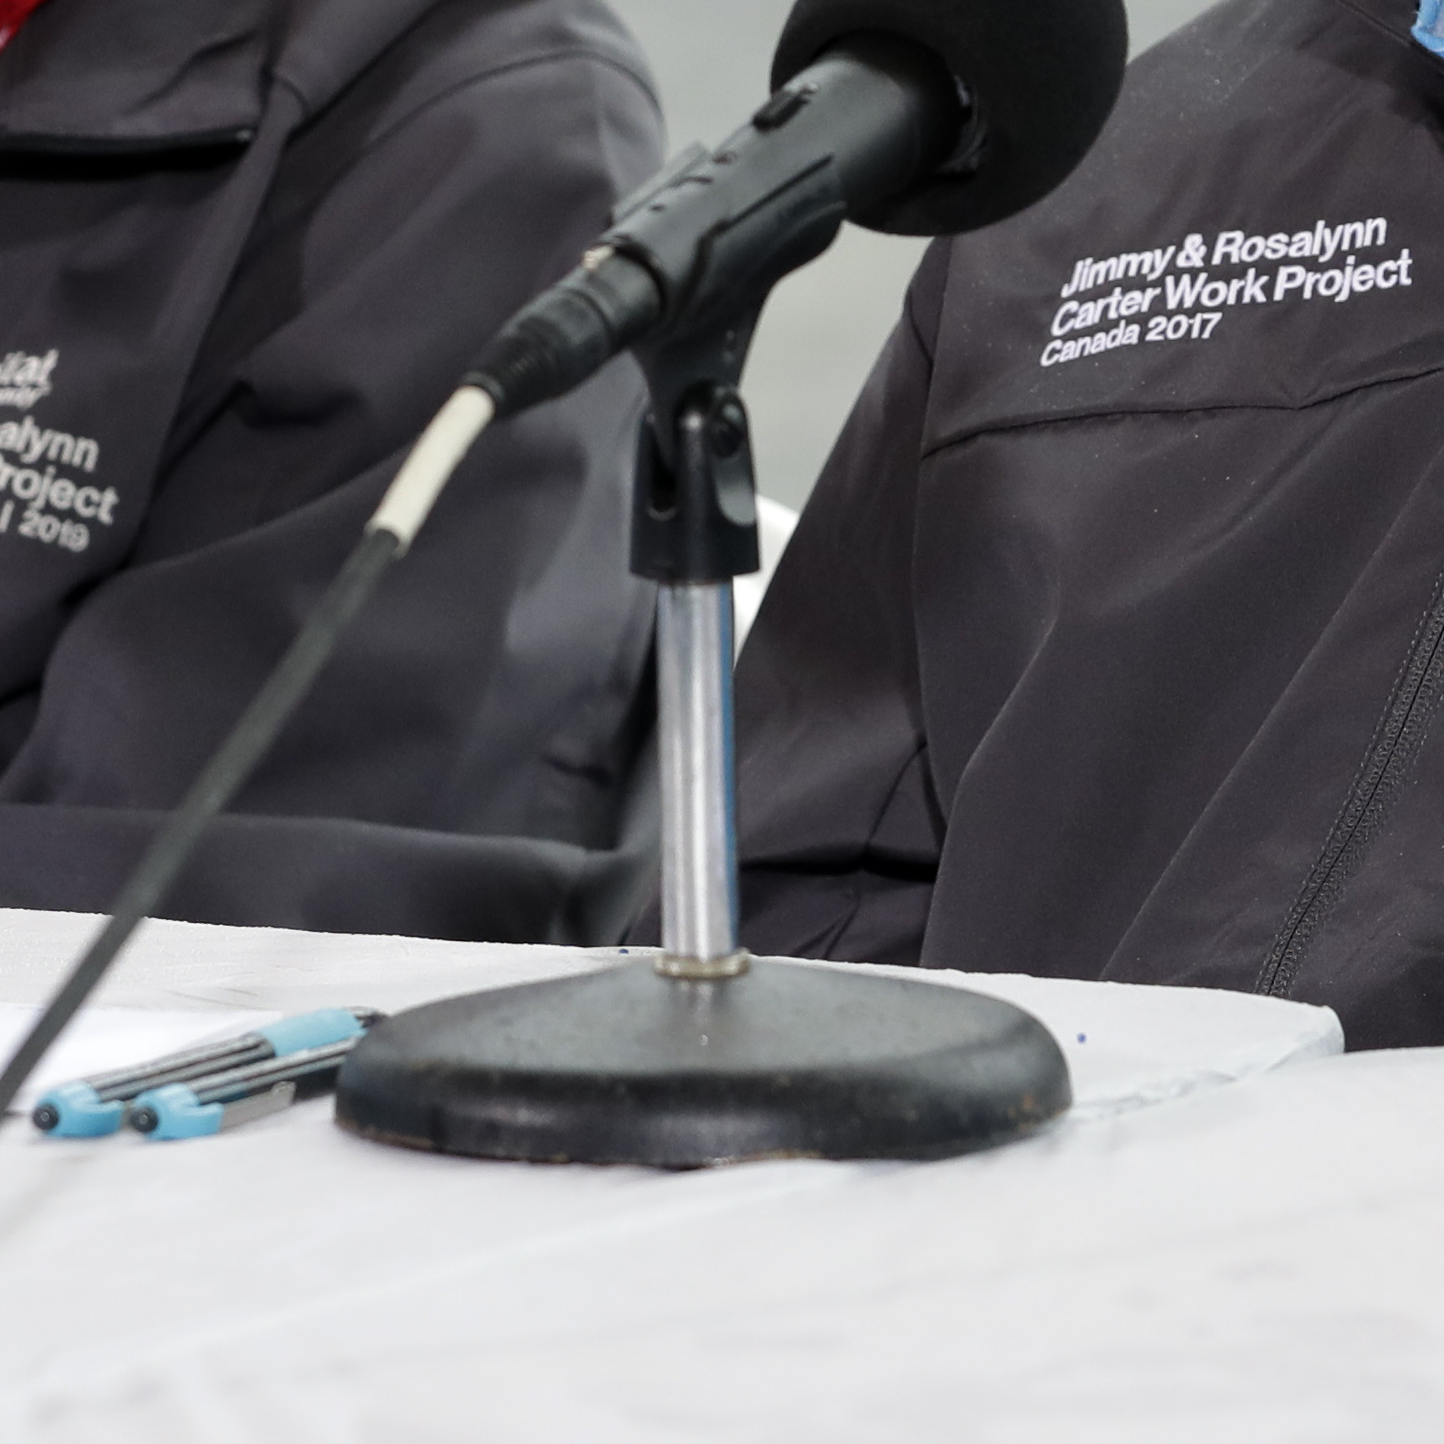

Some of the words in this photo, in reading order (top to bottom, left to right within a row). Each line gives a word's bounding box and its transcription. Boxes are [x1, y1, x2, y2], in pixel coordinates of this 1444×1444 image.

[1059, 243, 1176, 299] Jimmy
[1176, 232, 1208, 269] &
[1211, 216, 1388, 267] Rosalynn
[1050, 285, 1162, 338] Carter
[1164, 267, 1271, 311] Work
[1272, 248, 1414, 304] Project
[1039, 320, 1143, 369] Canada
[1144, 311, 1223, 343] 2017
[17, 507, 92, 553] 2019
